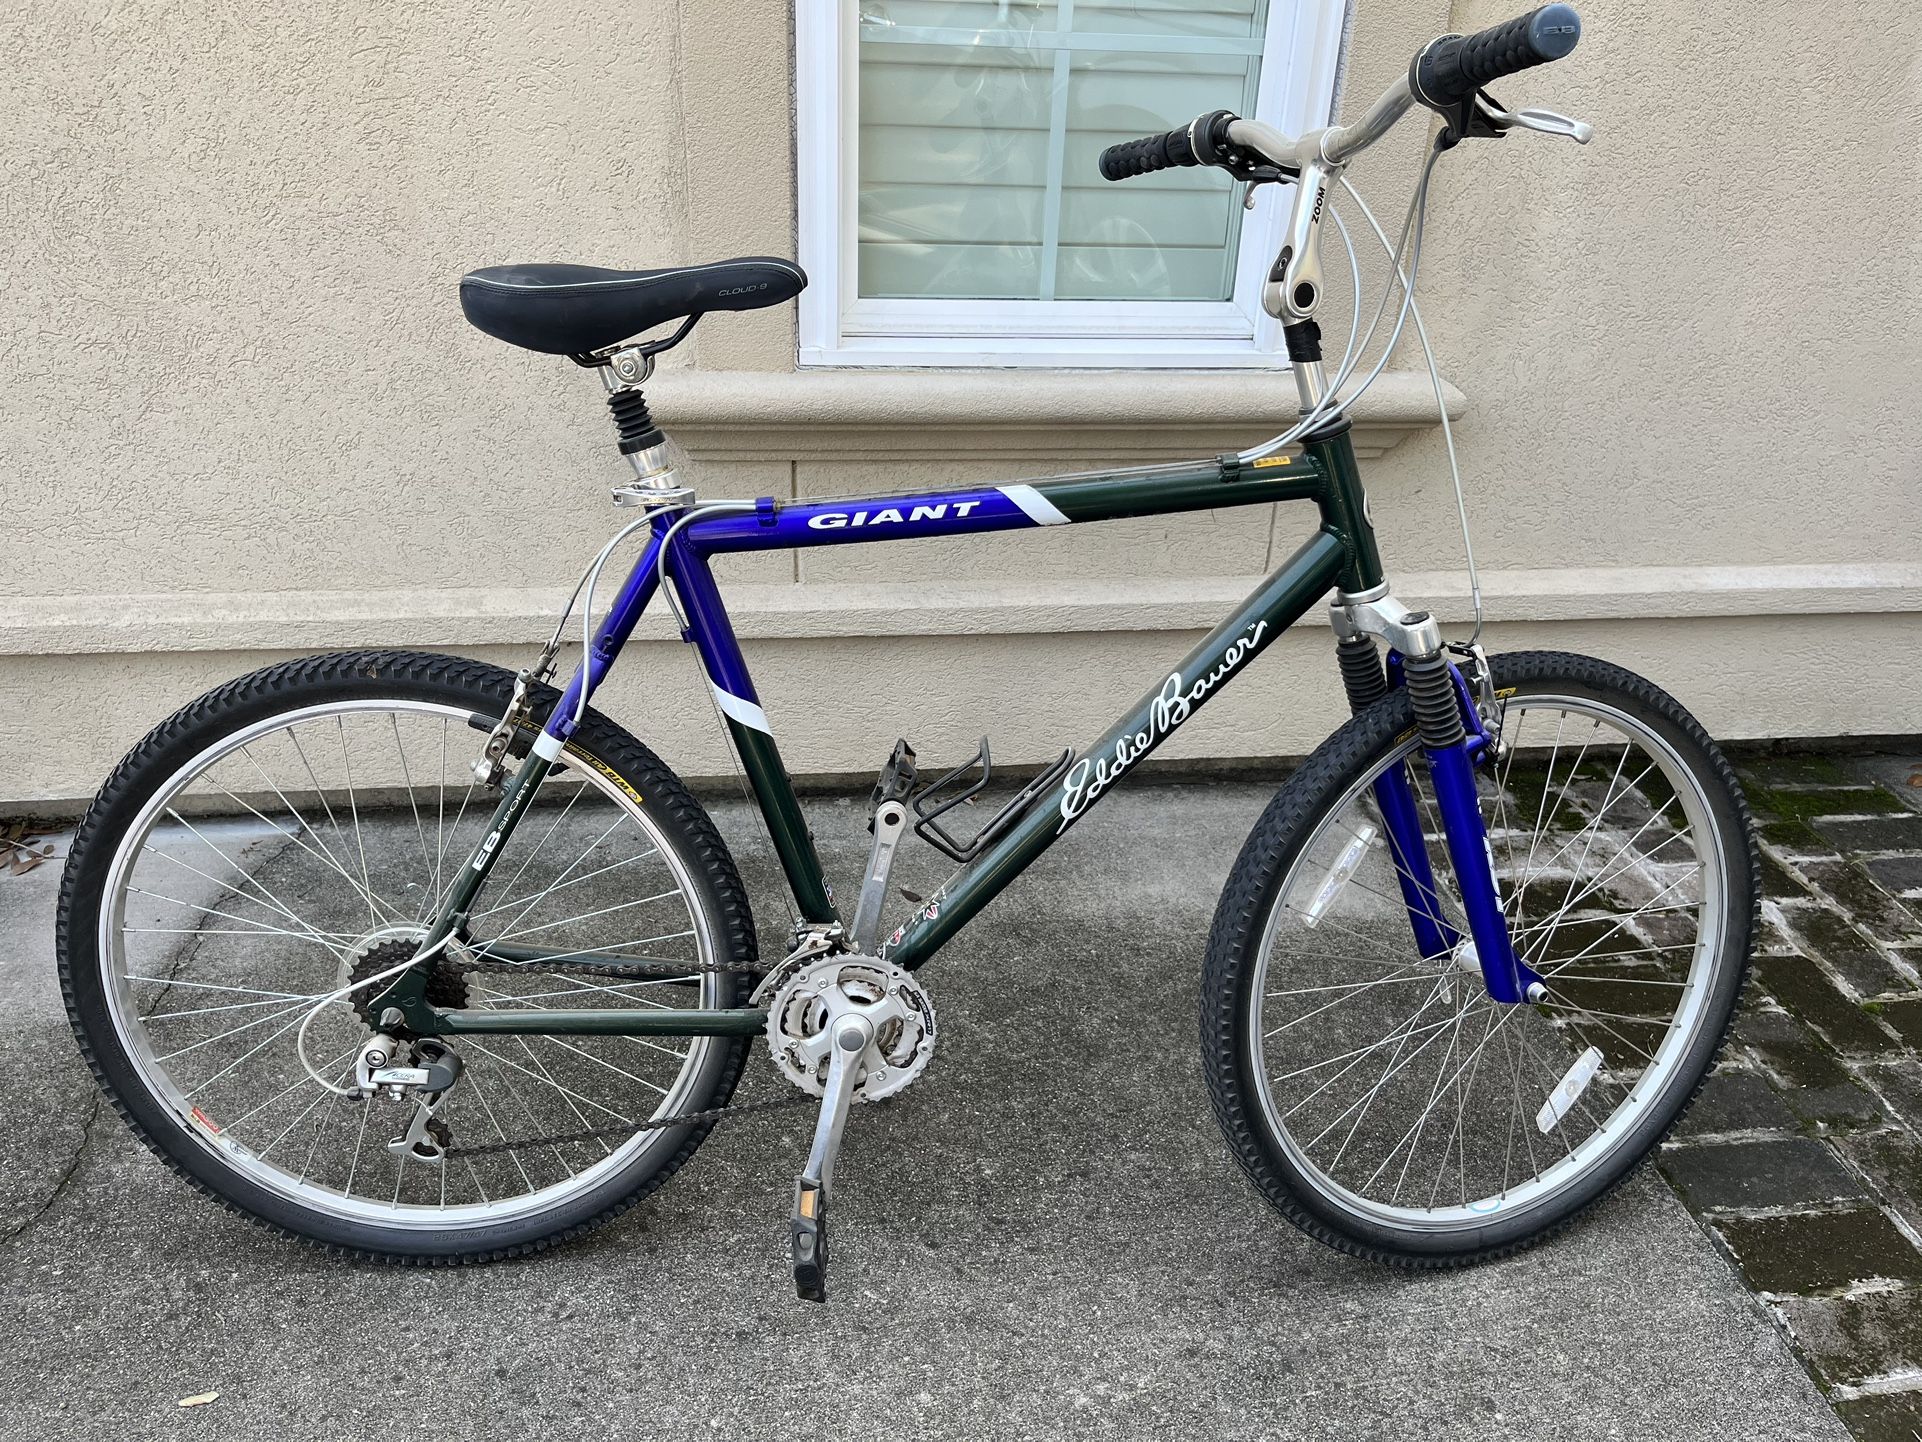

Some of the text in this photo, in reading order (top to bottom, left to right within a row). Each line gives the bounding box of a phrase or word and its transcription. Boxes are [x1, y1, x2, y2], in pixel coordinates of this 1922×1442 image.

[1311, 186, 1326, 225] ZOOM
[807, 501, 981, 530] GIANT
[1056, 731, 1152, 835] Eddie
[1150, 620, 1268, 733] Bauer
[605, 771, 630, 790] WTB
[471, 778, 530, 872] EB SPORT
